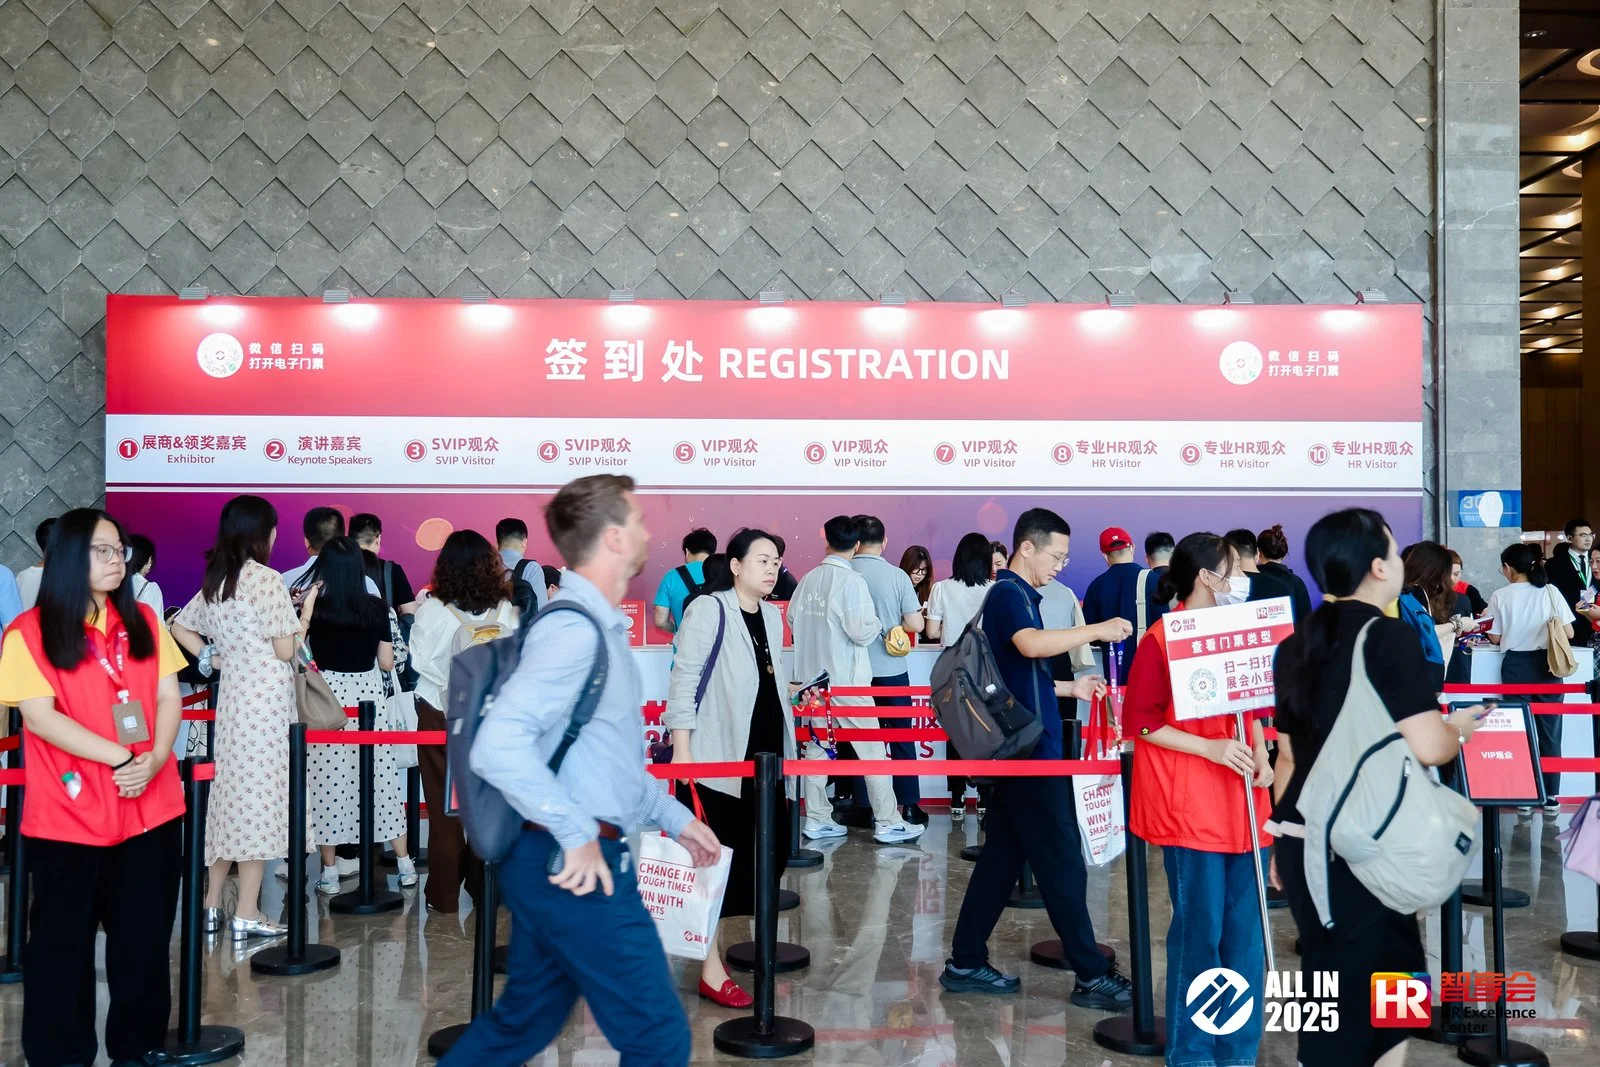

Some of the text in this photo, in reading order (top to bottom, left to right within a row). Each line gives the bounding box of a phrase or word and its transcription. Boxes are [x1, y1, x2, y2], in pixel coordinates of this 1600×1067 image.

[248, 342, 325, 355] 微信扫码
[248, 356, 325, 371] 打开电子门票
[543, 337, 1010, 383] 签到处 REGISTRATION
[1267, 350, 1340, 363] 微信扫码
[1267, 364, 1340, 377] 打开电子门票
[141, 434, 247, 451] 展商&领奖嘉宾
[297, 435, 362, 451] 演讲嘉宾
[431, 436, 499, 452] SVIP观众
[564, 437, 632, 453] SVIP观众
[701, 438, 759, 454] VIP观众
[831, 438, 889, 454] VIP观众
[961, 439, 1018, 455] VIP观众
[1075, 439, 1158, 455] 专业HR观众
[1203, 440, 1286, 456] 专业HR观众
[1331, 440, 1414, 456] 专业HR观众
[167, 454, 216, 464] Exhibitor
[287, 454, 373, 466] Keynote Speakers
[435, 455, 496, 465] SVIP Visitor
[568, 456, 628, 466] SVIP Visitor
[703, 457, 757, 467] VIP Visitor
[833, 457, 887, 467] VIP Visitor
[963, 458, 1017, 468] VIP Visitor
[1091, 458, 1142, 468] HR Visitor
[1220, 459, 1270, 469] HR Visitor
[1348, 459, 1398, 469] HR Visitor
[1191, 630, 1272, 654] 查看门票类型
[1224, 654, 1271, 674] 扫一扫打
[1226, 670, 1274, 690] 展会小程
[1481, 750, 1514, 760] VIP观众
[1085, 798, 1112, 812] TOUGH
[1087, 812, 1107, 826] WIN
[639, 862, 696, 883] CHANGE IN
[638, 875, 693, 894] TOUGH TIMES
[657, 891, 684, 909] WITH
[645, 903, 665, 915] ARTS
